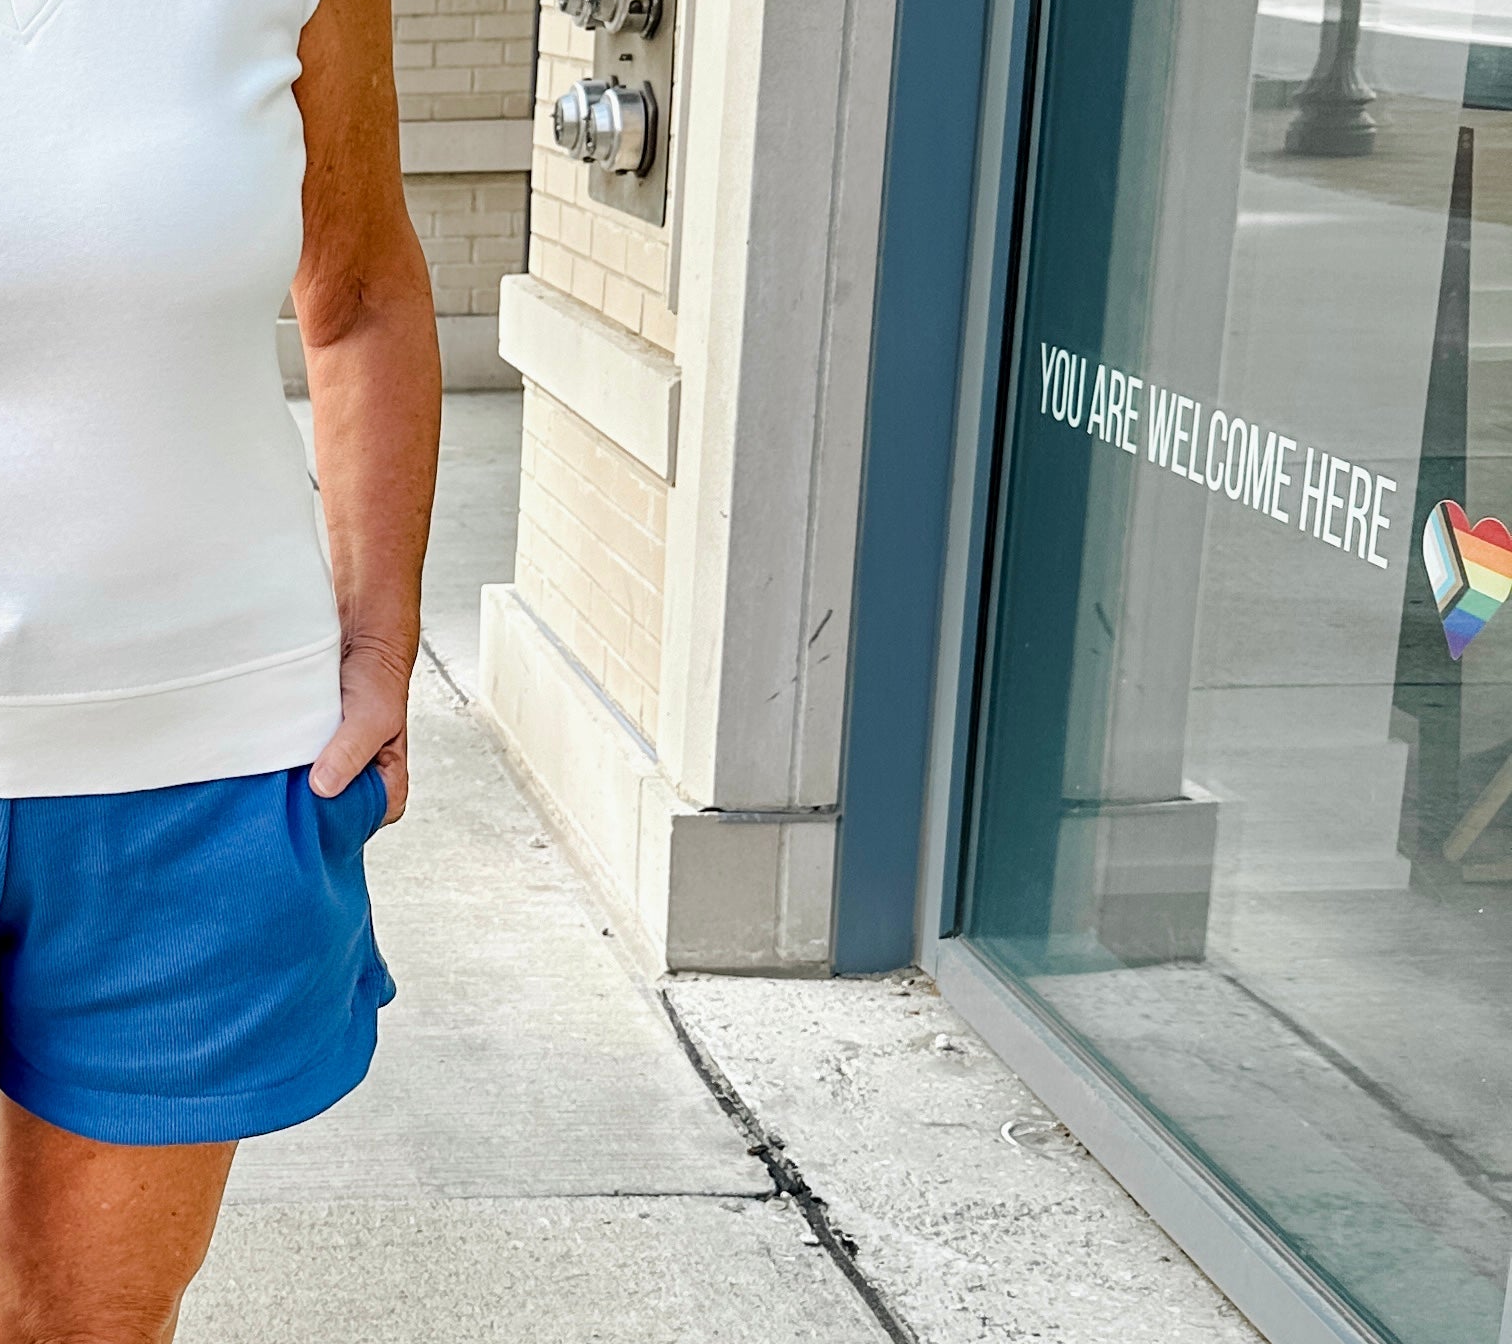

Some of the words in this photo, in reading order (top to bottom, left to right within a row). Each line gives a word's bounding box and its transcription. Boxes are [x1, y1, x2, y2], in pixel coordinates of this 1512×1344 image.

[1041, 342, 1087, 429] YOU
[1087, 364, 1143, 455] ARE
[1147, 384, 1297, 524] WELCOME
[1299, 447, 1397, 570] HERE
